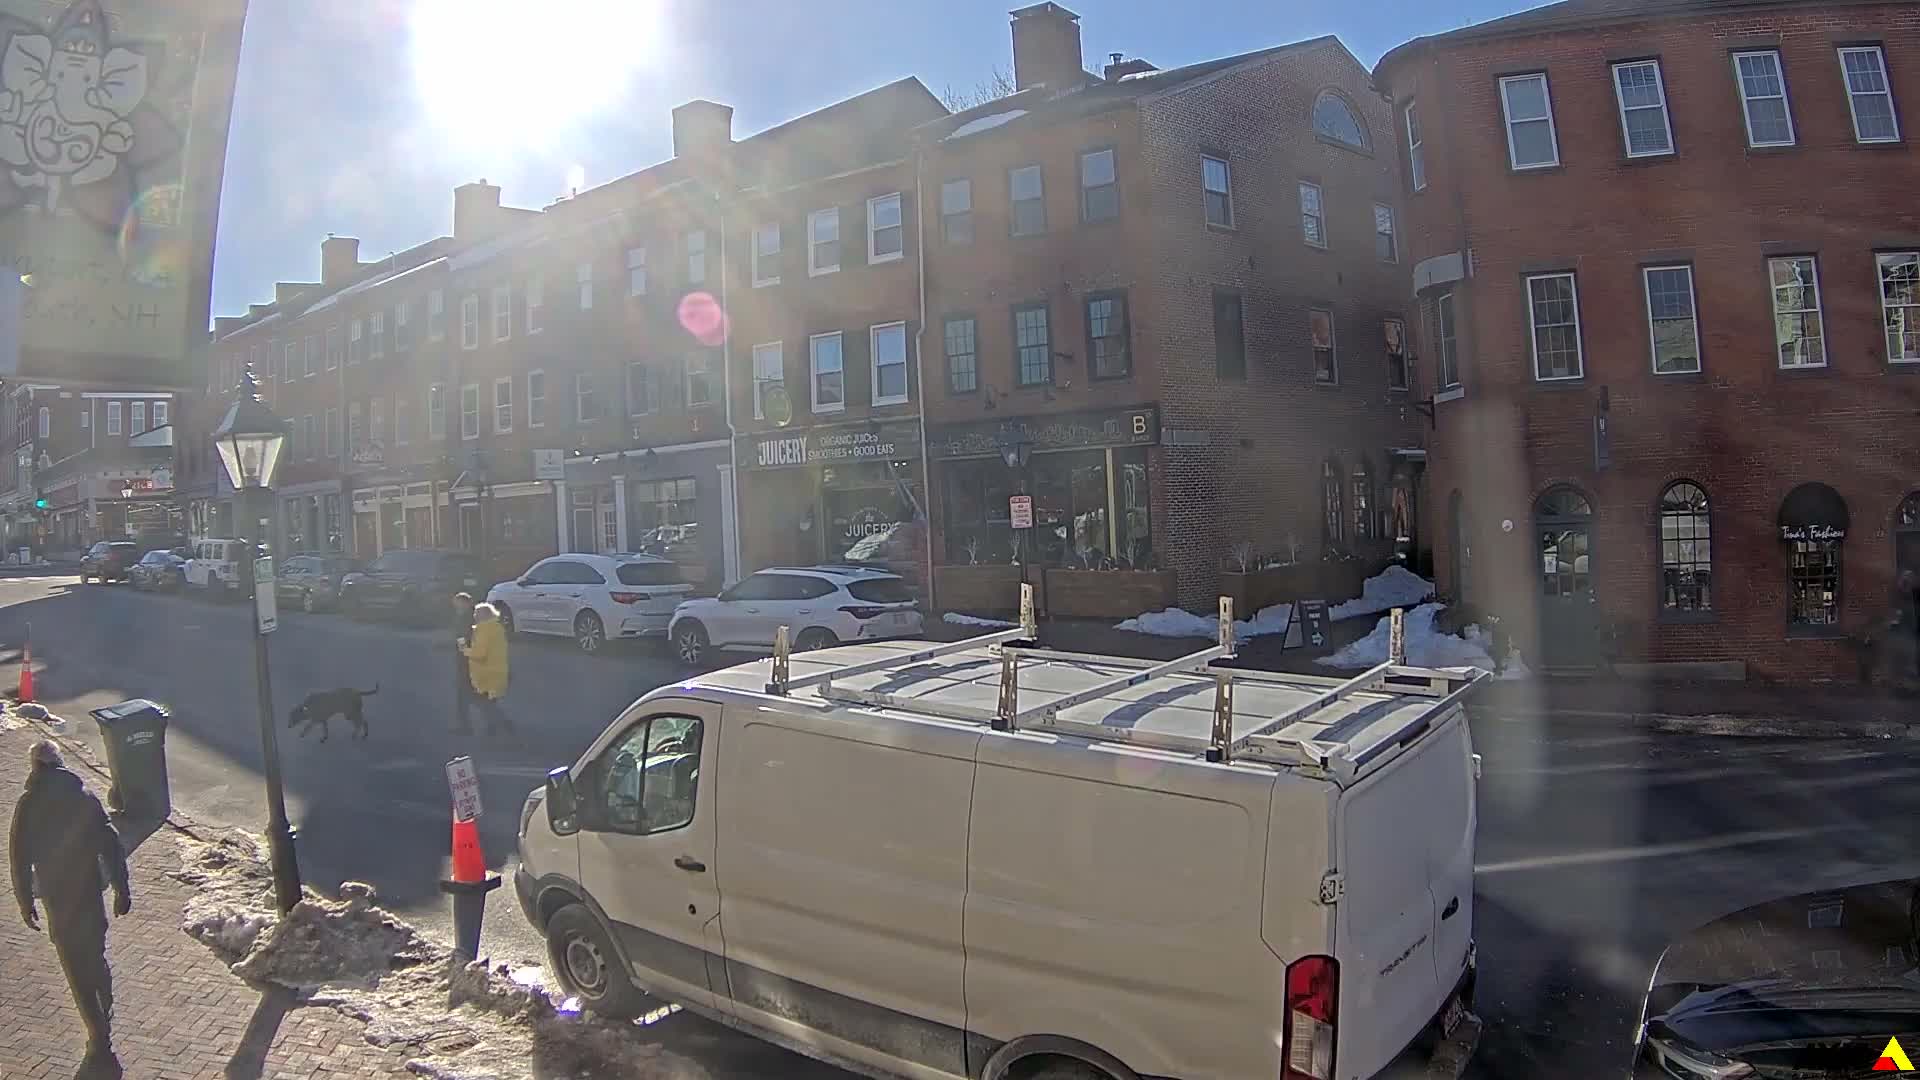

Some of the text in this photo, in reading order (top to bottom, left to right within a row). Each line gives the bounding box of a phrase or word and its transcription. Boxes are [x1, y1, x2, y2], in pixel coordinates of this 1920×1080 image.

[1133, 416, 1146, 434] B
[759, 438, 807, 465] JUICERY
[854, 446, 876, 455] GOOD
[877, 444, 895, 454] EATS
[846, 522, 896, 536] JUICERY
